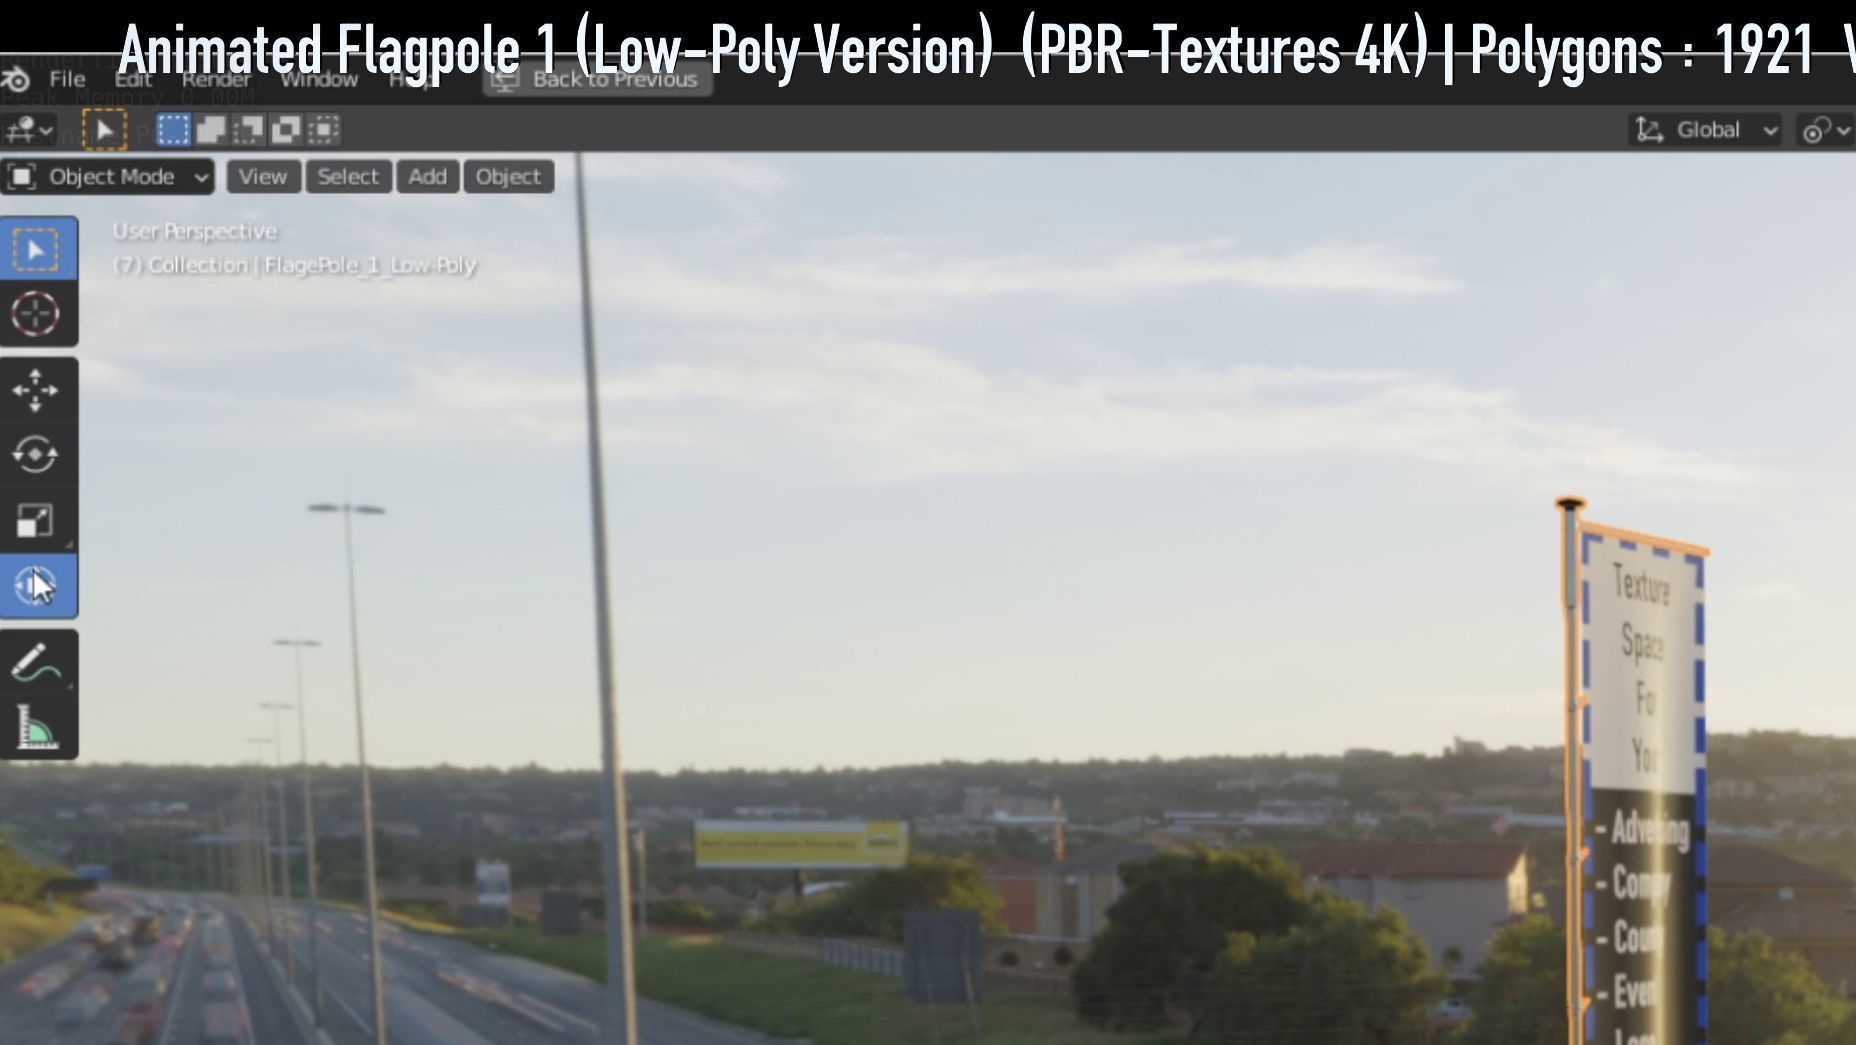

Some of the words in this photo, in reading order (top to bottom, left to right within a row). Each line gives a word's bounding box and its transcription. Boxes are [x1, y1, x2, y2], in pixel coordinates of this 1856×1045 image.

[51, 70, 85, 87] File
[115, 72, 152, 88] Edit
[183, 71, 252, 88] Render
[281, 71, 359, 88] Window
[534, 71, 584, 88] Back
[588, 72, 609, 88] to
[614, 72, 698, 88] Previous
[1679, 121, 1739, 137] Global
[51, 168, 114, 188] Object
[122, 168, 174, 184] Mode
[239, 168, 287, 184] View
[319, 169, 378, 184] Select
[409, 168, 446, 184] Add
[477, 168, 541, 188] Object
[112, 222, 159, 242] User
[163, 222, 279, 246] Perspective
[111, 256, 143, 276] (7)
[148, 256, 250, 276] Collection
